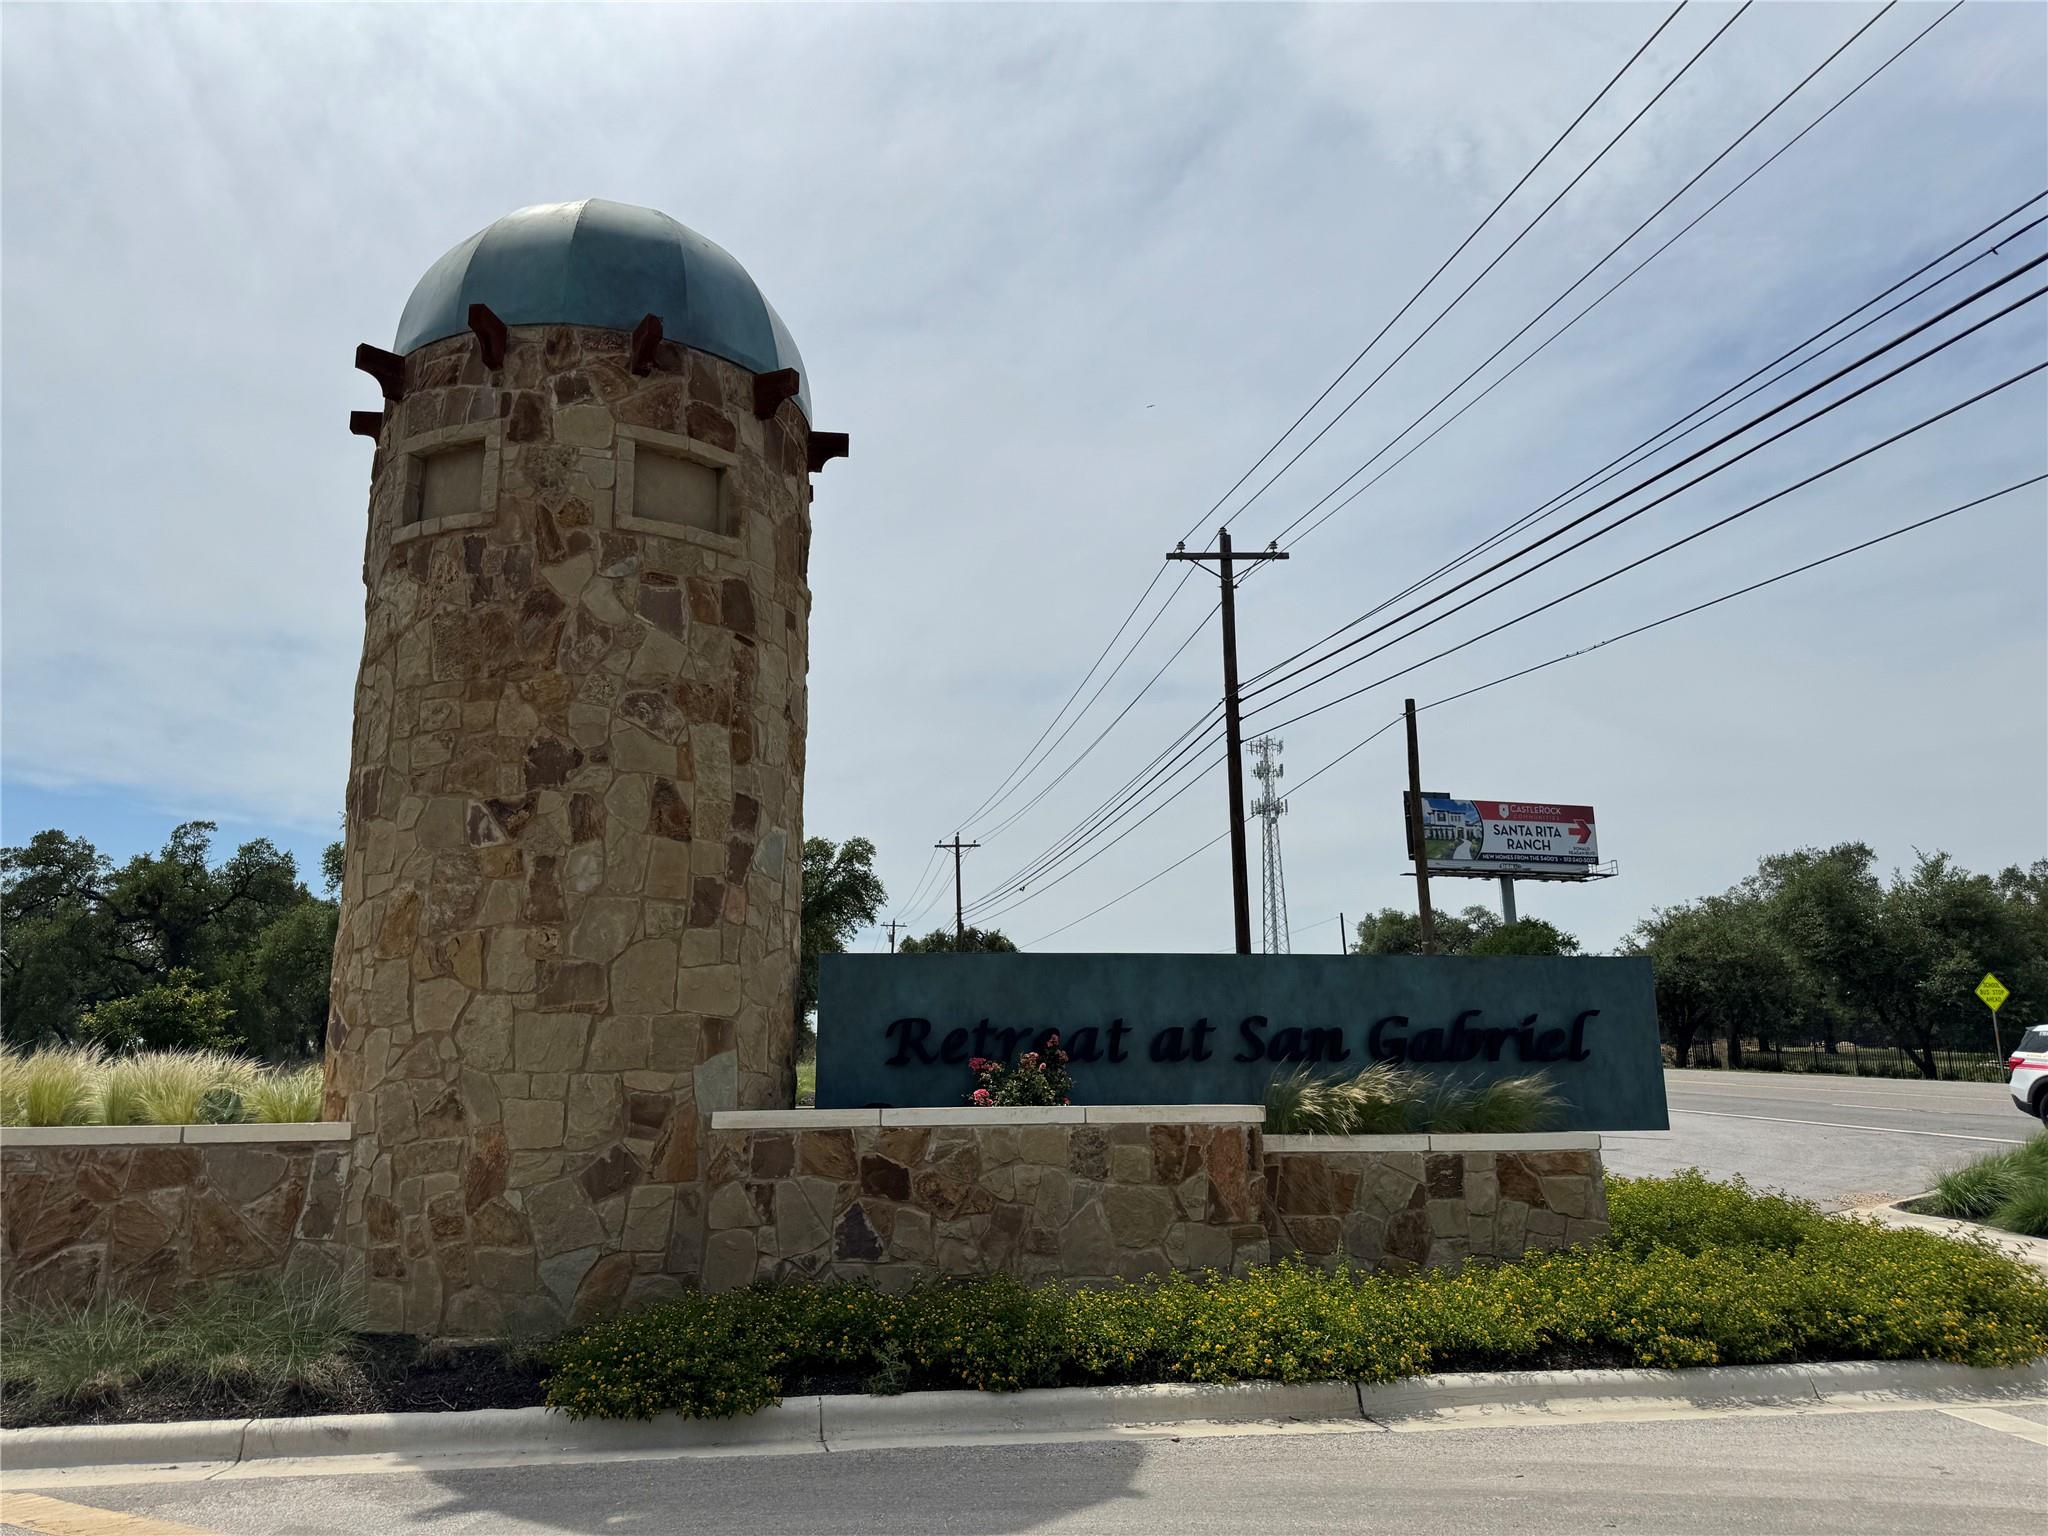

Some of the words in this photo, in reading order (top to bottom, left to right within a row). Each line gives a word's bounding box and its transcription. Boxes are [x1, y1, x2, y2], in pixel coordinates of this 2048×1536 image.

[1493, 823, 1533, 838] SANTA
[1536, 826, 1562, 838] RITA
[1507, 838, 1551, 851] RANCH
[1149, 1017, 1217, 1063] at
[1234, 1015, 1351, 1063] San
[1367, 1009, 1601, 1064] Gabriel
